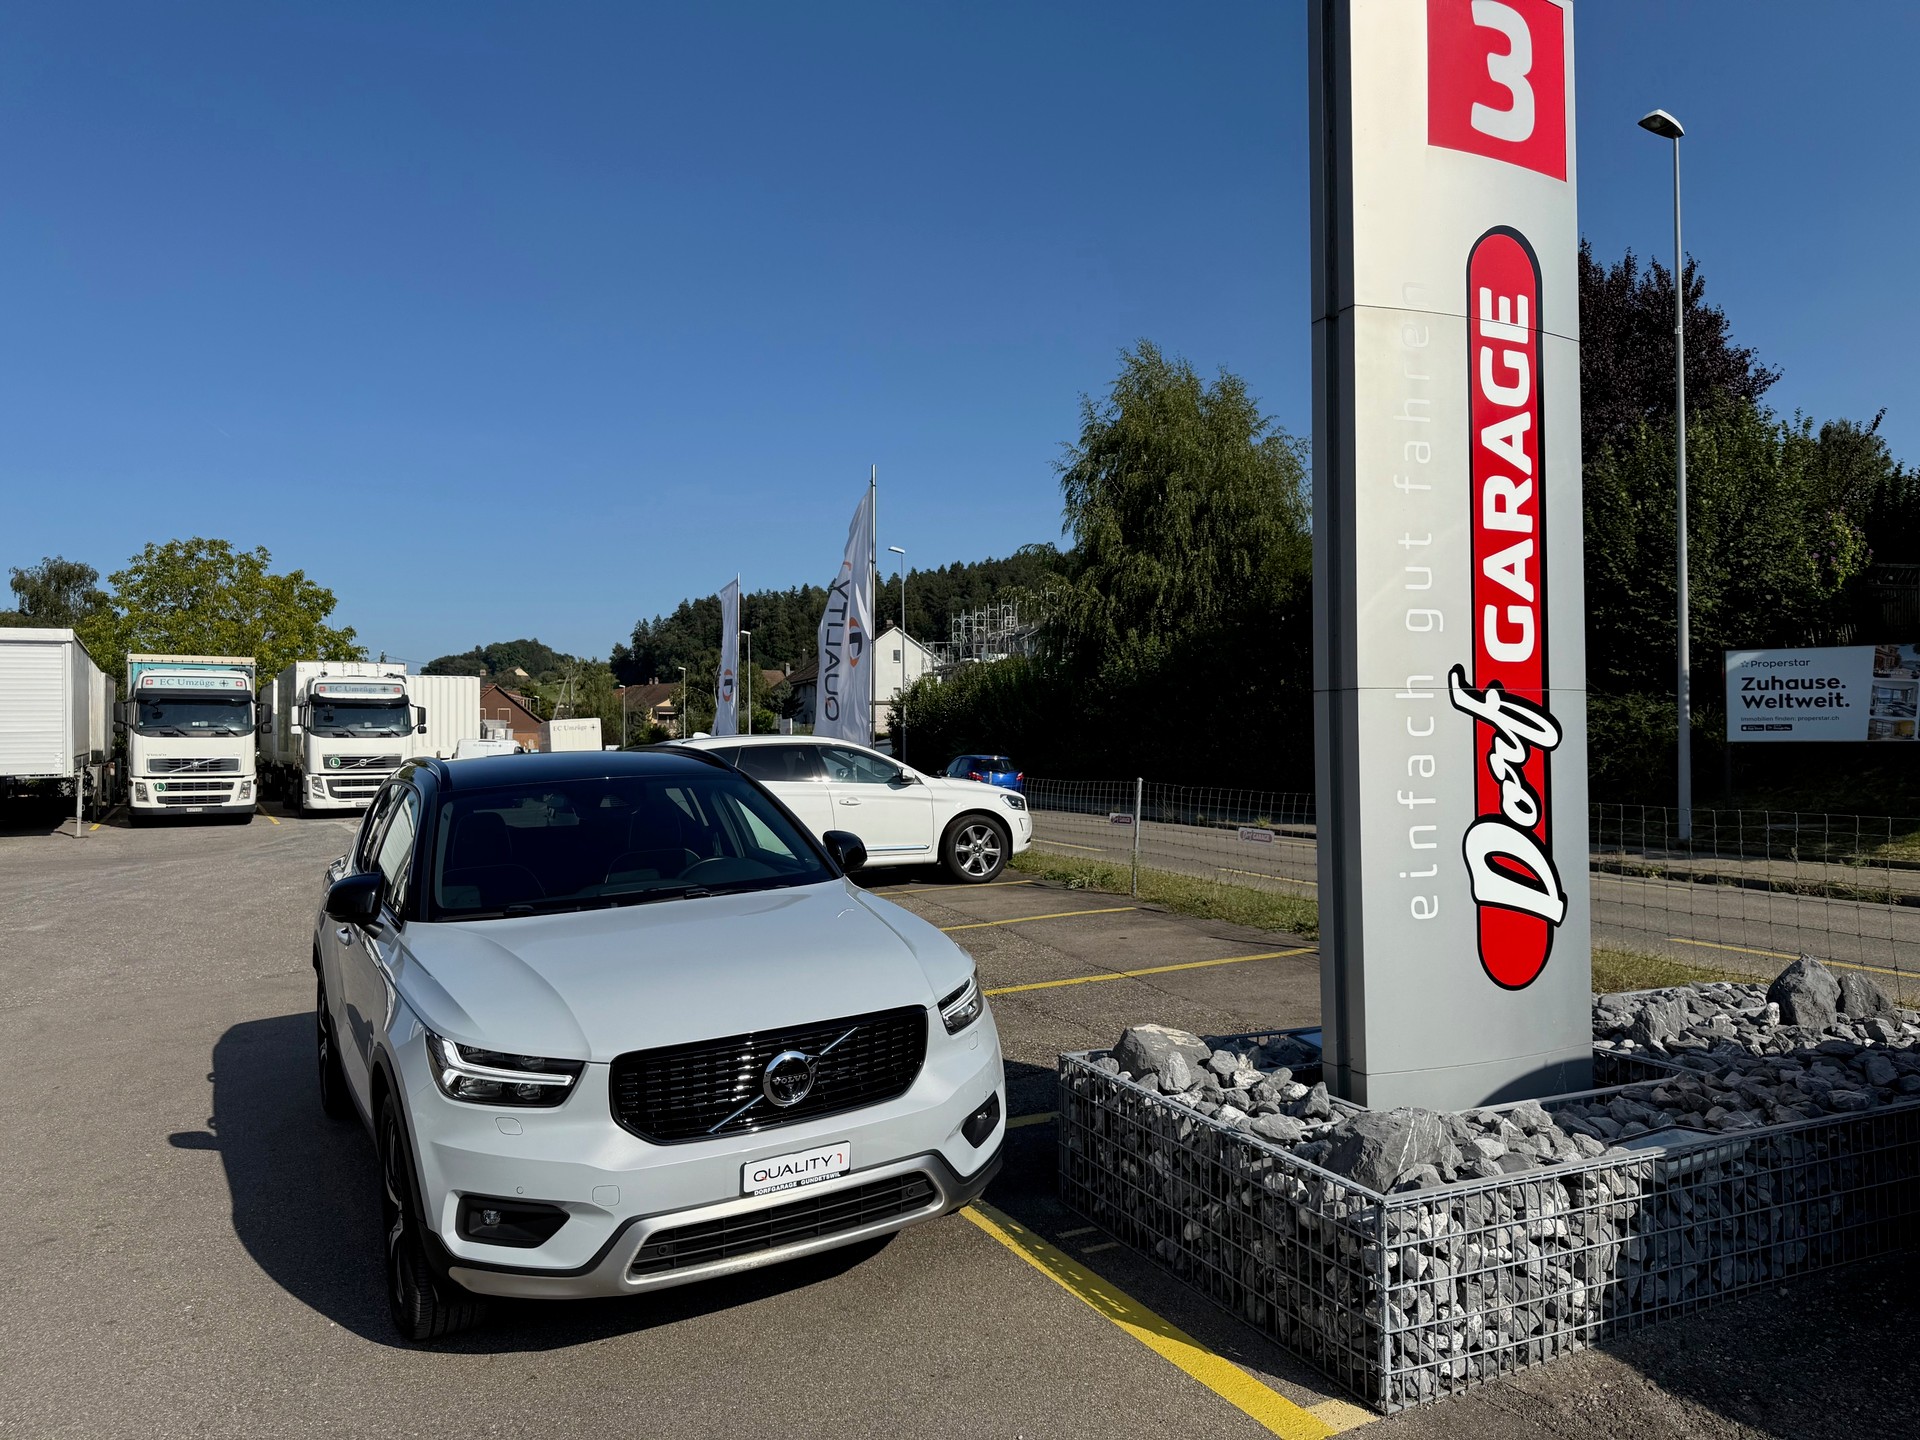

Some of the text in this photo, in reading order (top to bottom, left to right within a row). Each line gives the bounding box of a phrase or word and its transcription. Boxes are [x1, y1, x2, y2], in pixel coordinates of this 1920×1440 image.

[1392, 280, 1444, 921] einfach gut fahren
[1450, 286, 1565, 925] Dorf GARAGE
[1750, 658, 1811, 669] Properstar
[159, 678, 216, 689] EC Umzüge
[329, 685, 343, 694] EC
[1741, 675, 1847, 692] Zuhause.
[1741, 691, 1850, 709] Weltweit.
[772, 1073, 808, 1086] VOLVO
[753, 1153, 843, 1183] QUALITY 1
[754, 1181, 798, 1196] DORFGARAGE
